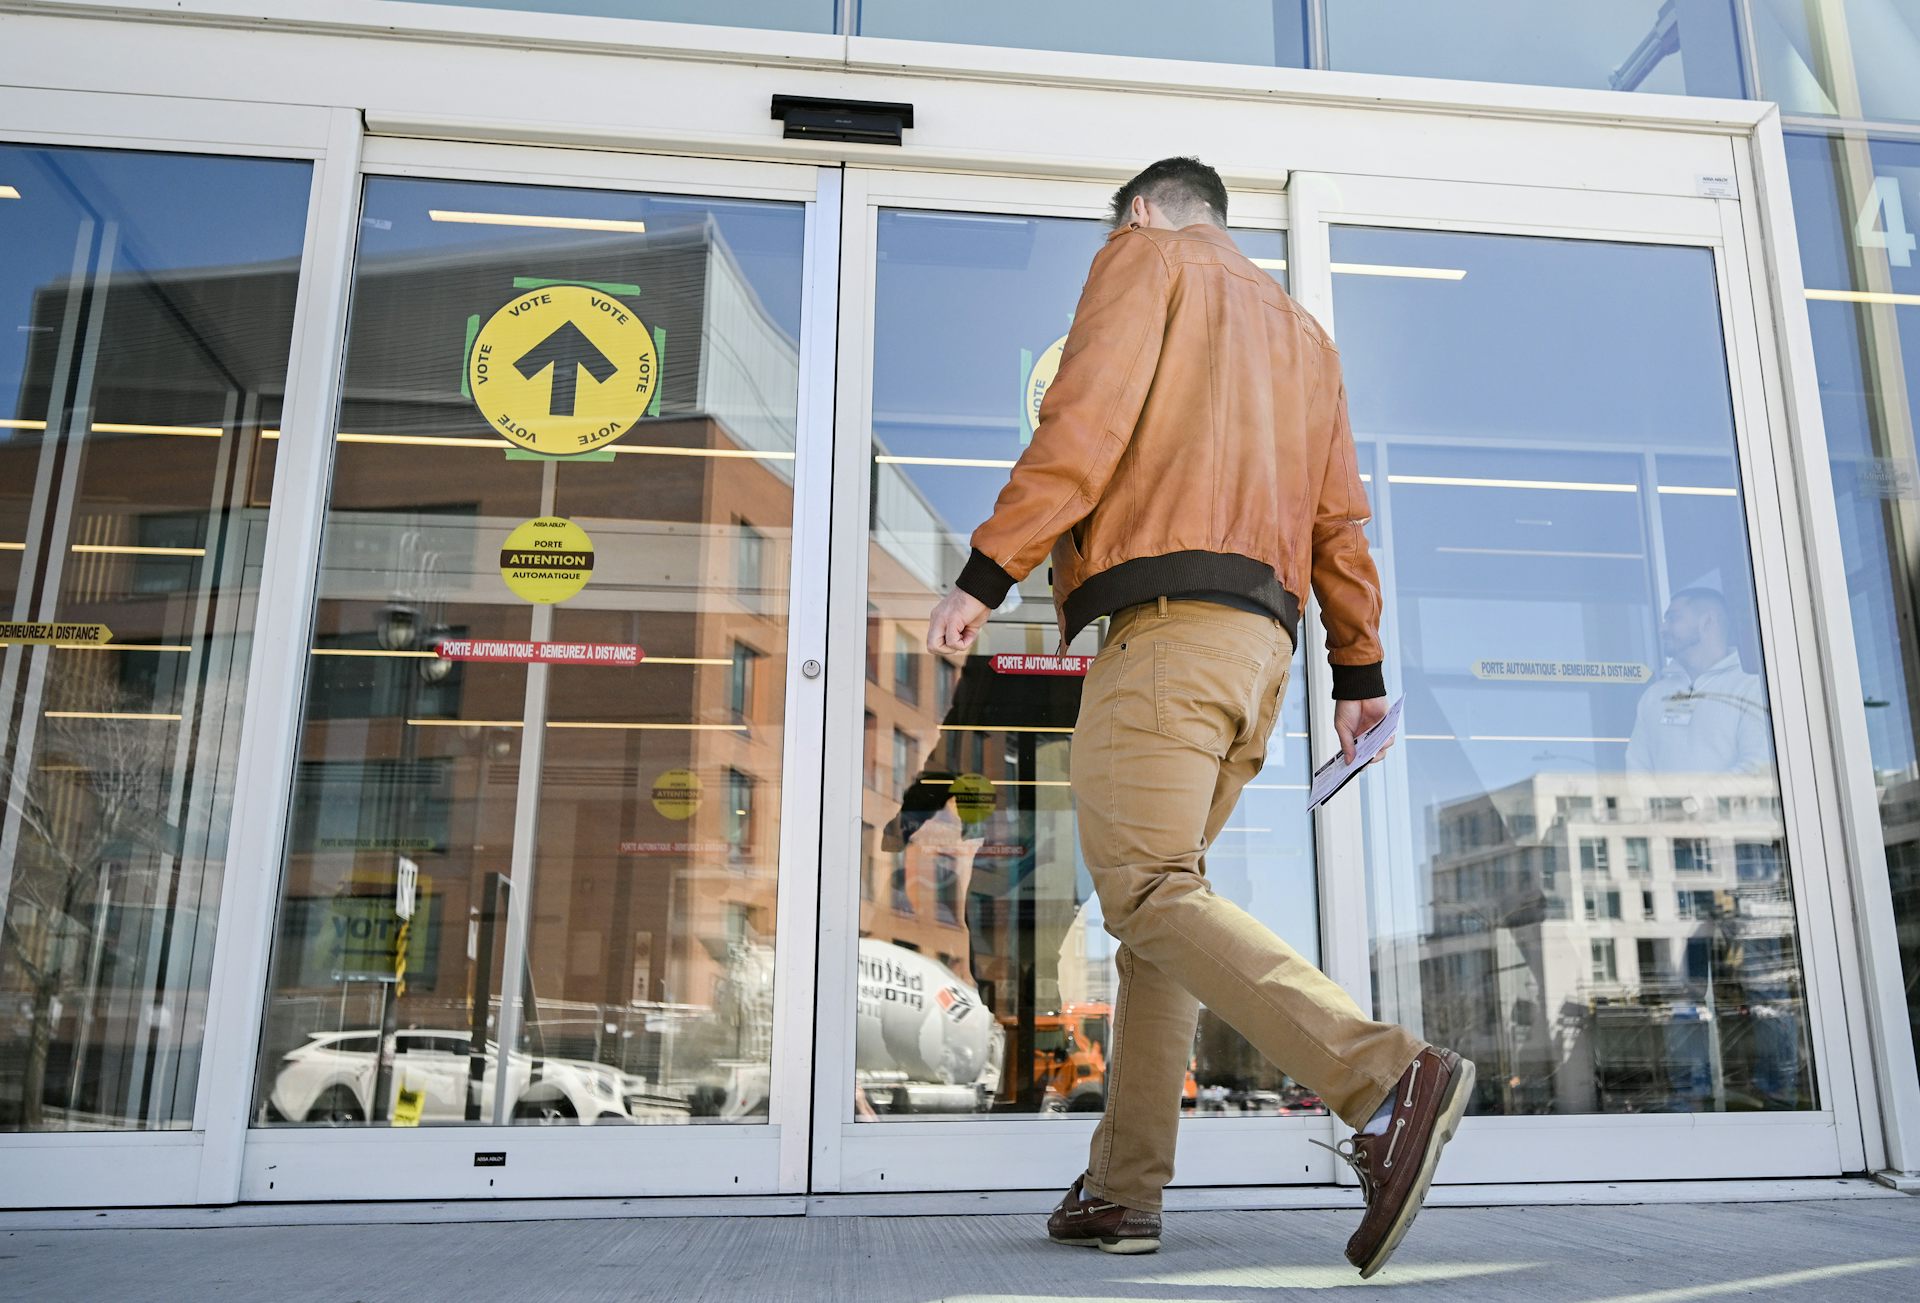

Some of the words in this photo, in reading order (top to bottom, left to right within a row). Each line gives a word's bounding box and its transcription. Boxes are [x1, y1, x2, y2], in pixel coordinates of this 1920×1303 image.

[1855, 176, 1916, 267] 4
[508, 293, 552, 318] VOTE
[590, 296, 629, 325] VOTE
[477, 343, 492, 385] VOTE
[636, 353, 650, 393] VOTE
[497, 414, 537, 443] VOTE
[577, 421, 622, 445] VOTE
[534, 540, 563, 549] PORTE
[509, 554, 586, 566] ATTENTION
[512, 571, 581, 580] AUTOMATIQUE
[0, 624, 47, 639] DEMEUREZ
[47, 623, 54, 639] À
[56, 626, 100, 640] DISTANCE
[442, 642, 471, 656] PORTE
[472, 642, 534, 658] AUTOMATIQUE
[540, 644, 585, 659] DEMEUREZ
[595, 646, 636, 660] DISTANCE
[997, 655, 1024, 670] PORTE
[1481, 661, 1504, 675] PORTE
[1506, 662, 1557, 676] AUTOMATIQUE
[1562, 664, 1600, 677] DEMEUREZ
[1607, 665, 1642, 678] DISTANCE
